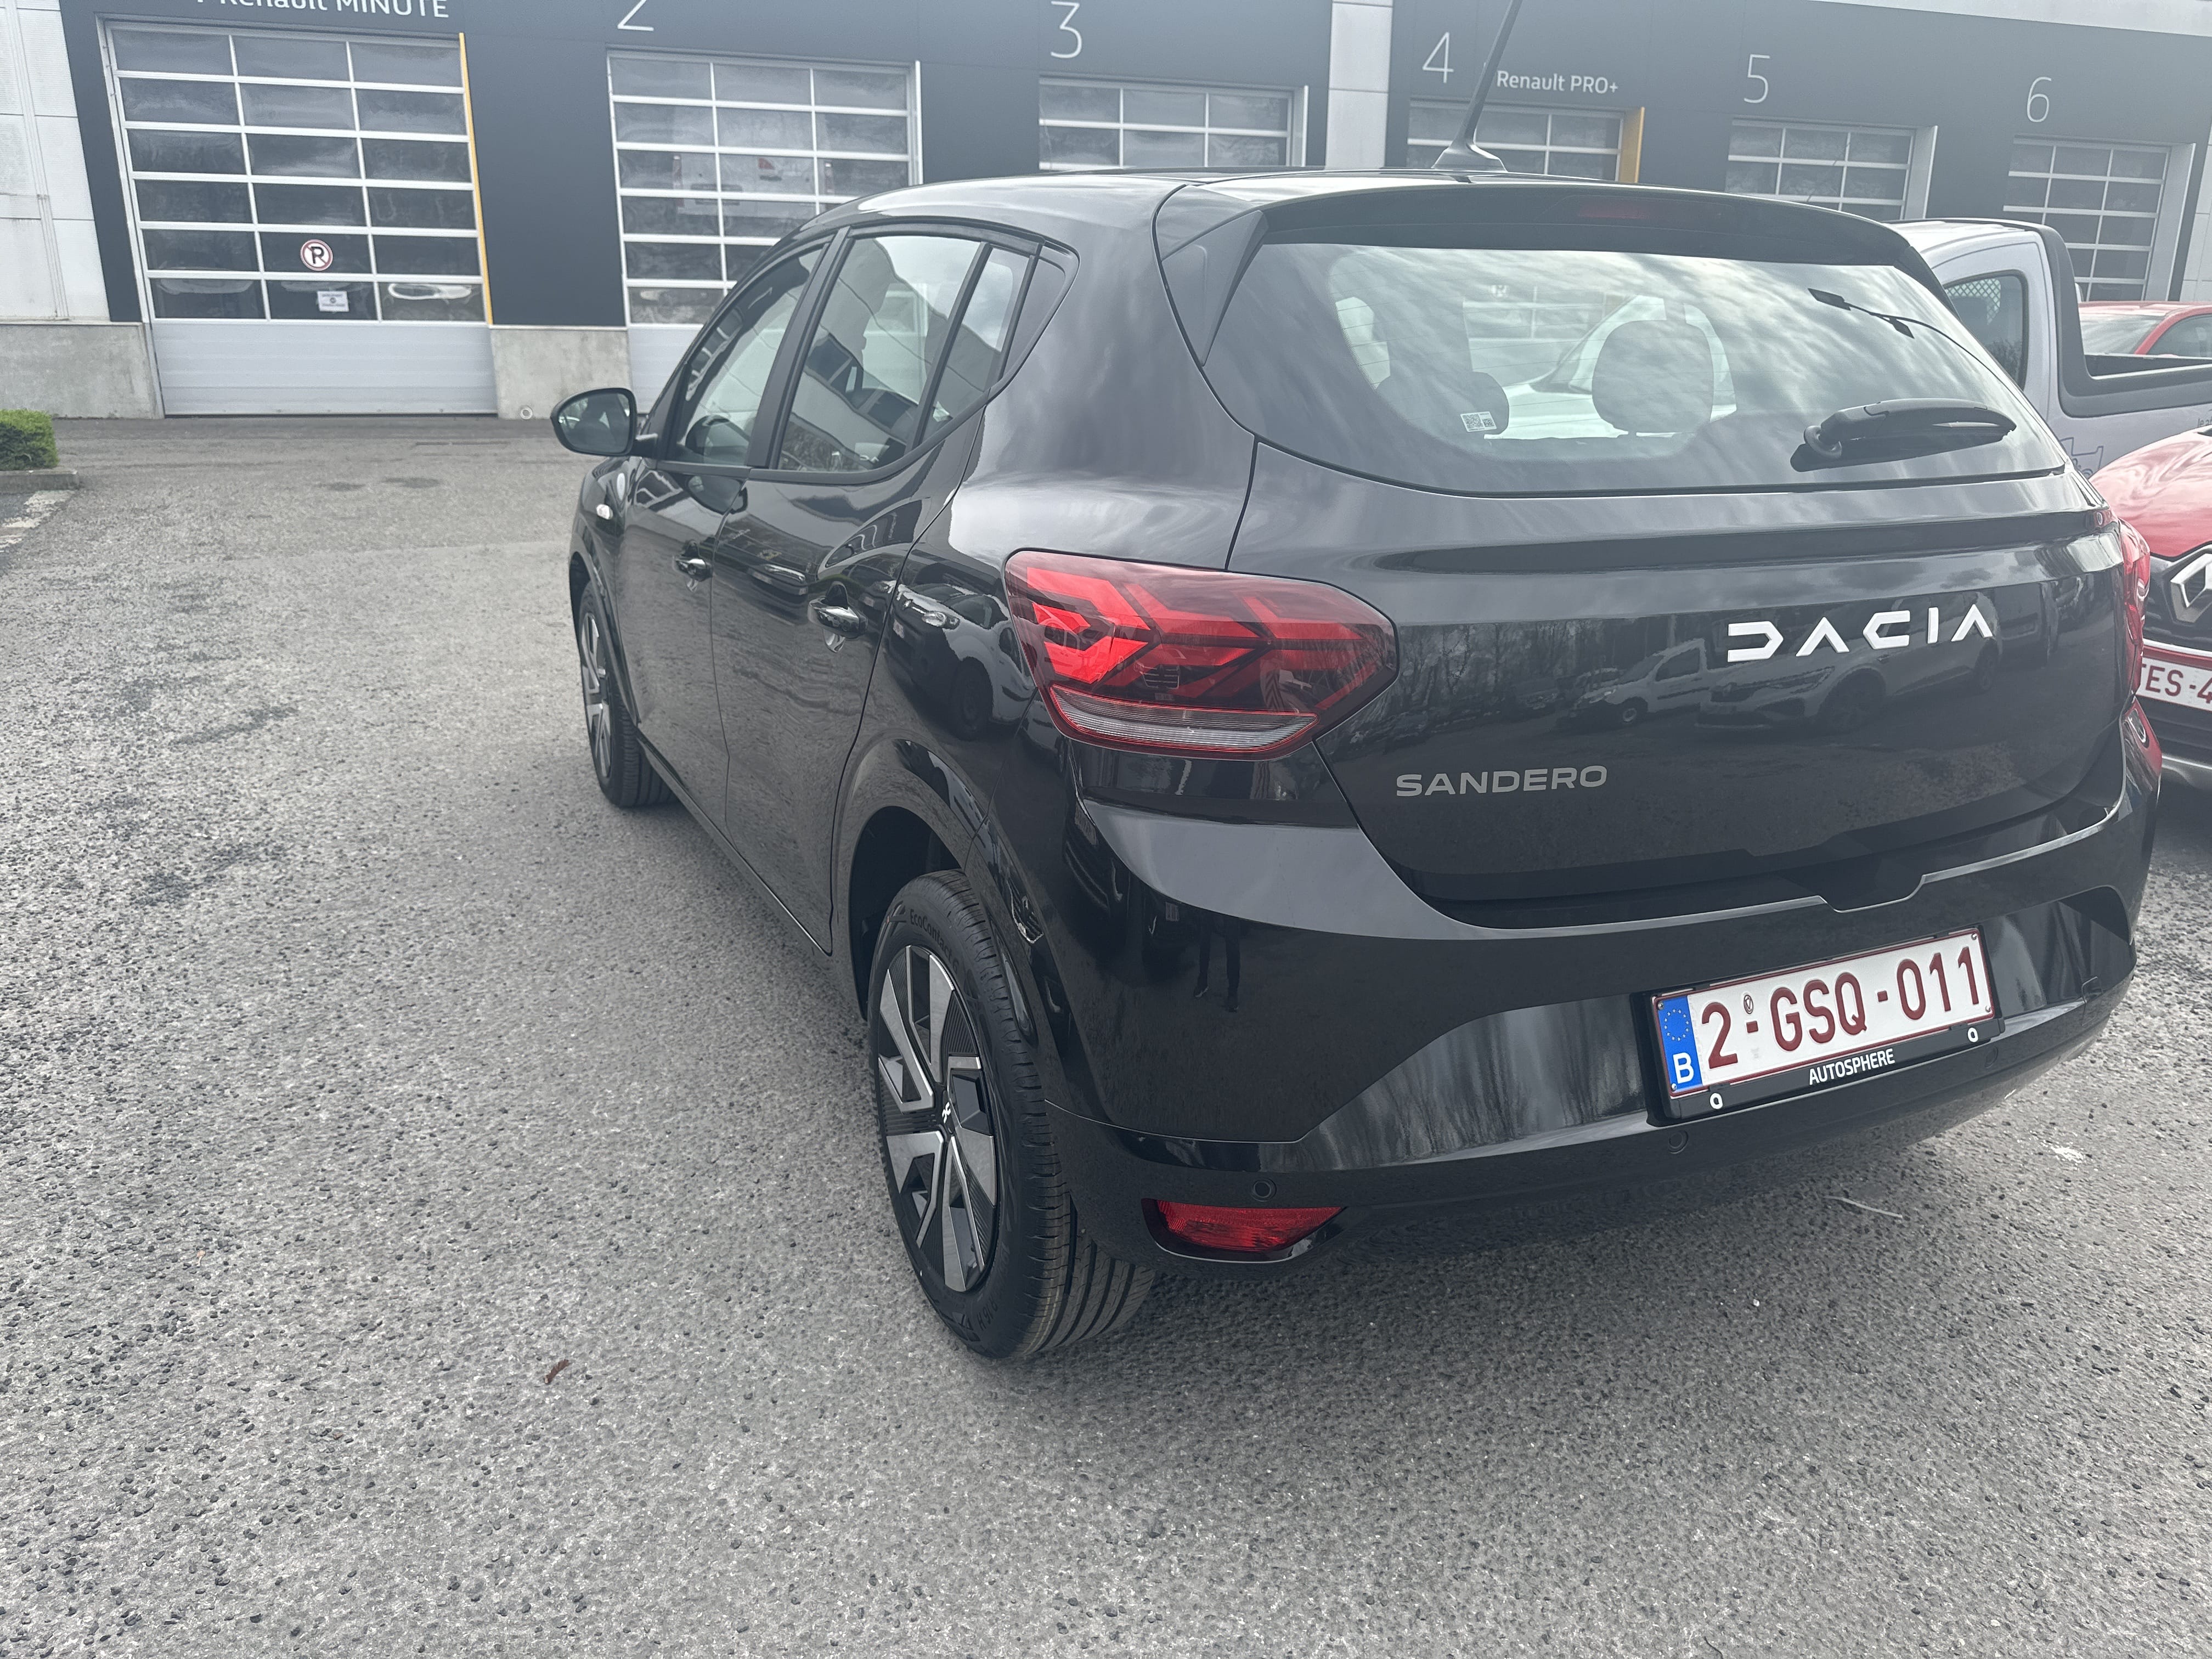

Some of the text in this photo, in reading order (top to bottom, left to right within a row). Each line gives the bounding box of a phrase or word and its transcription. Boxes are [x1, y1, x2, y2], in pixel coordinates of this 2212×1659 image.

[336, 0, 449, 18] MINUTE
[1051, 1, 1082, 59] 3
[1422, 31, 1454, 83] 4
[1497, 70, 1619, 94] Renault PRO+
[1743, 54, 1770, 104] 5
[2027, 76, 2052, 122] 6
[311, 246, 325, 264] P
[1727, 603, 1994, 663] DACIA
[2142, 663, 2212, 704] ES-4
[1396, 765, 1608, 797] SANDERO
[910, 908, 952, 963] EcoContact
[1701, 946, 1980, 1070] 2-GSQ-011
[1673, 1052, 1694, 1085] B
[1809, 1048, 1895, 1086] AUTOSPHERE
